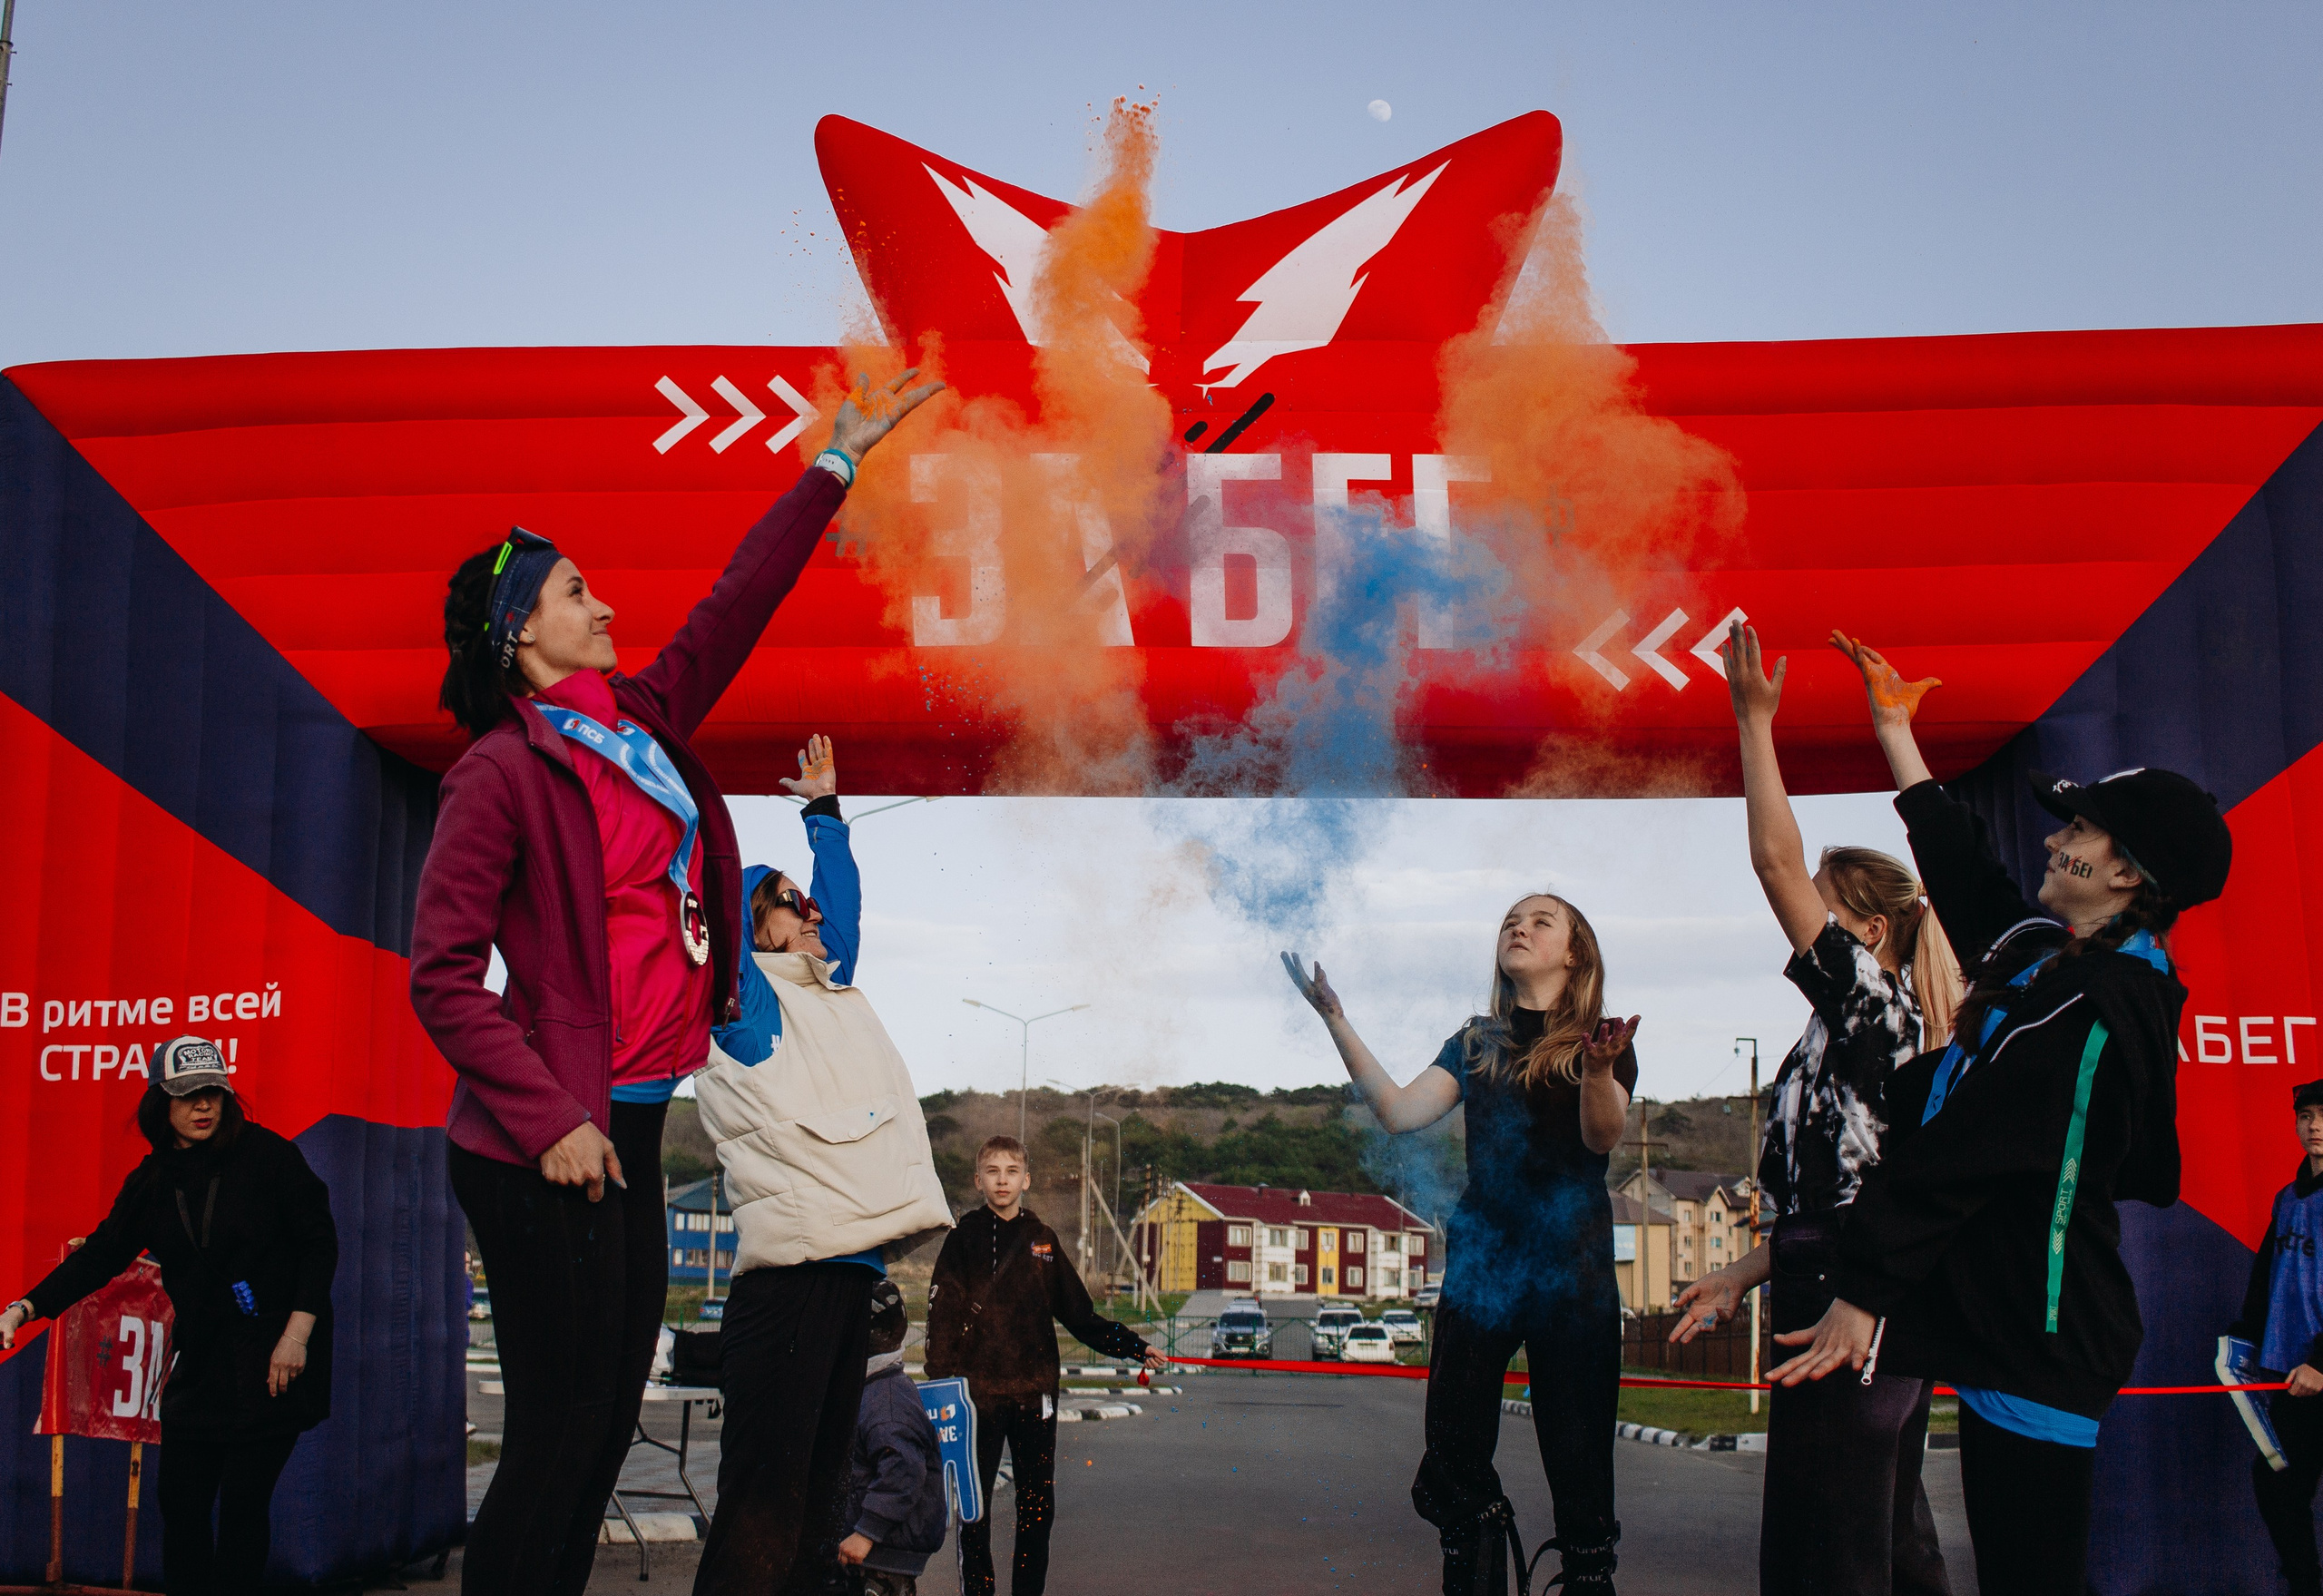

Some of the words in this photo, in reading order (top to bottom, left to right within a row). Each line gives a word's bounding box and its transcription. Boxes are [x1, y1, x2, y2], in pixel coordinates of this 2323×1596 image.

[910, 453, 1493, 650] ЗАБЕГ
[500, 630, 518, 669] ORT
[579, 723, 605, 745] ПСБ
[1, 992, 29, 1028] В
[43, 996, 173, 1033] ритме
[188, 981, 281, 1023] всей
[40, 1038, 238, 1082] СТРА!
[2177, 1014, 2317, 1065] БЕГ
[2054, 1187, 2069, 1225] SPORT
